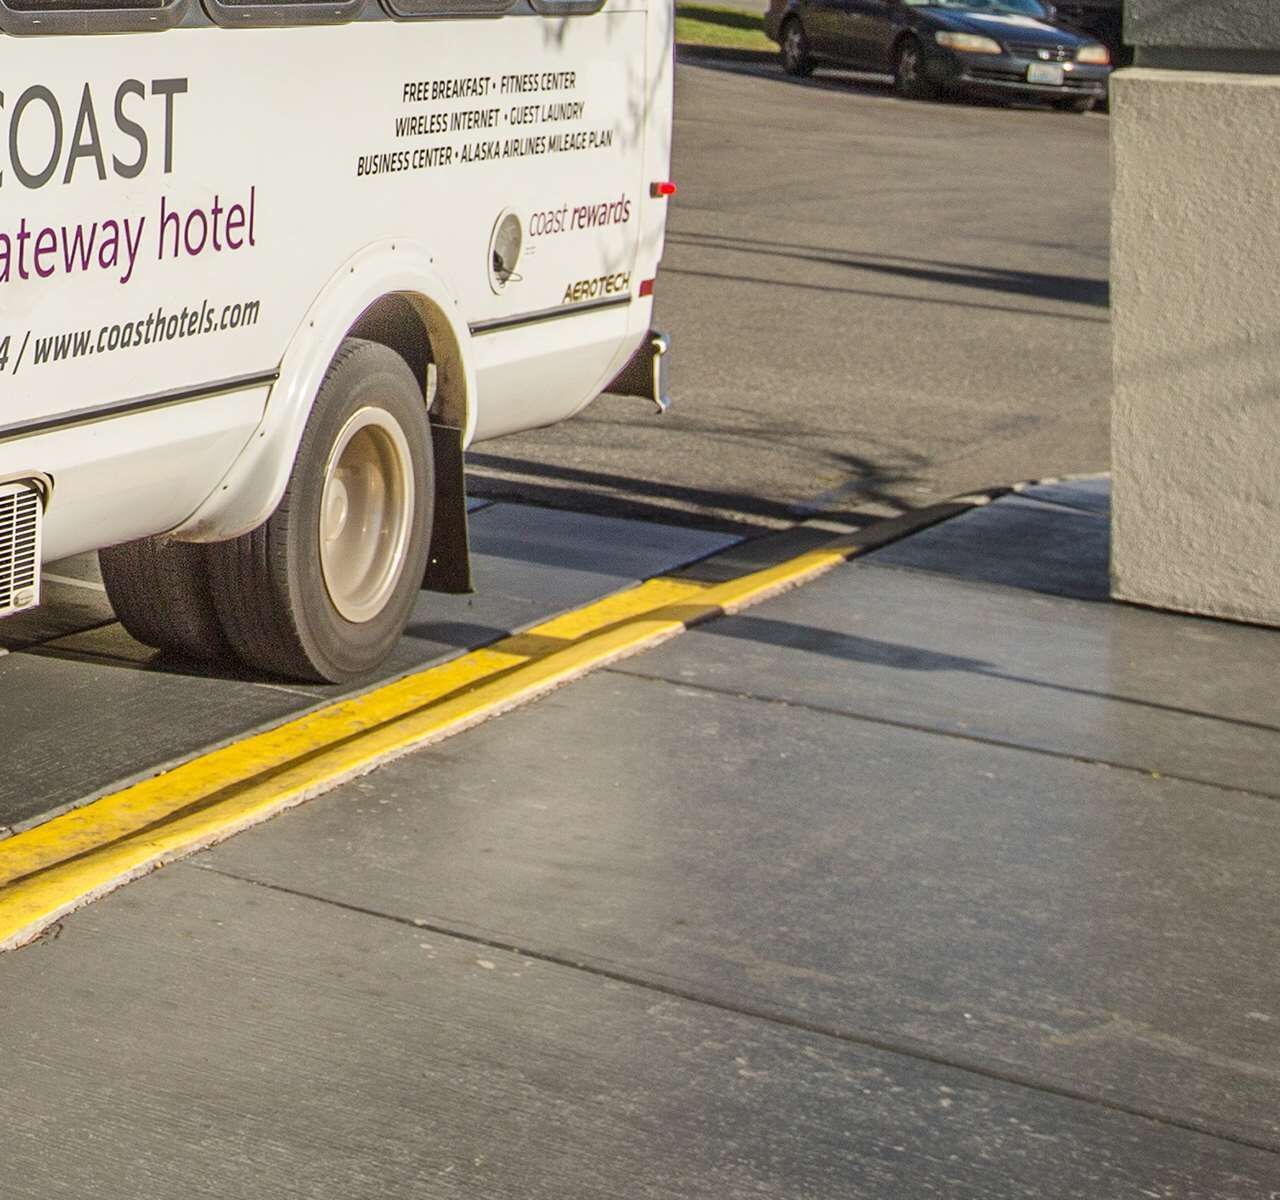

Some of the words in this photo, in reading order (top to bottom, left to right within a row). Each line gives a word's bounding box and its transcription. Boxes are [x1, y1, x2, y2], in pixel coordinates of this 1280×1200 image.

[402, 81, 430, 103] FREE
[431, 76, 490, 100] BREAKFAST
[500, 72, 540, 95] FITNESS
[540, 71, 577, 91] CENTER
[395, 112, 449, 137] WIRELESS
[449, 108, 501, 133] INTERNET
[509, 104, 540, 126] GUEST
[541, 101, 585, 122] LAUNDRY
[356, 151, 410, 177] BUSINESS
[411, 146, 453, 169] CENTER
[460, 139, 501, 163] ALASKA
[502, 135, 546, 160] AIRLINES
[547, 132, 589, 153] MILEAGE
[588, 129, 614, 149] PLAN
[157, 185, 256, 260] hotel
[528, 203, 569, 237] coast
[569, 192, 632, 231] rewards
[561, 271, 632, 304] AEROTECH
[33, 298, 261, 365] www.coasthotels.com
